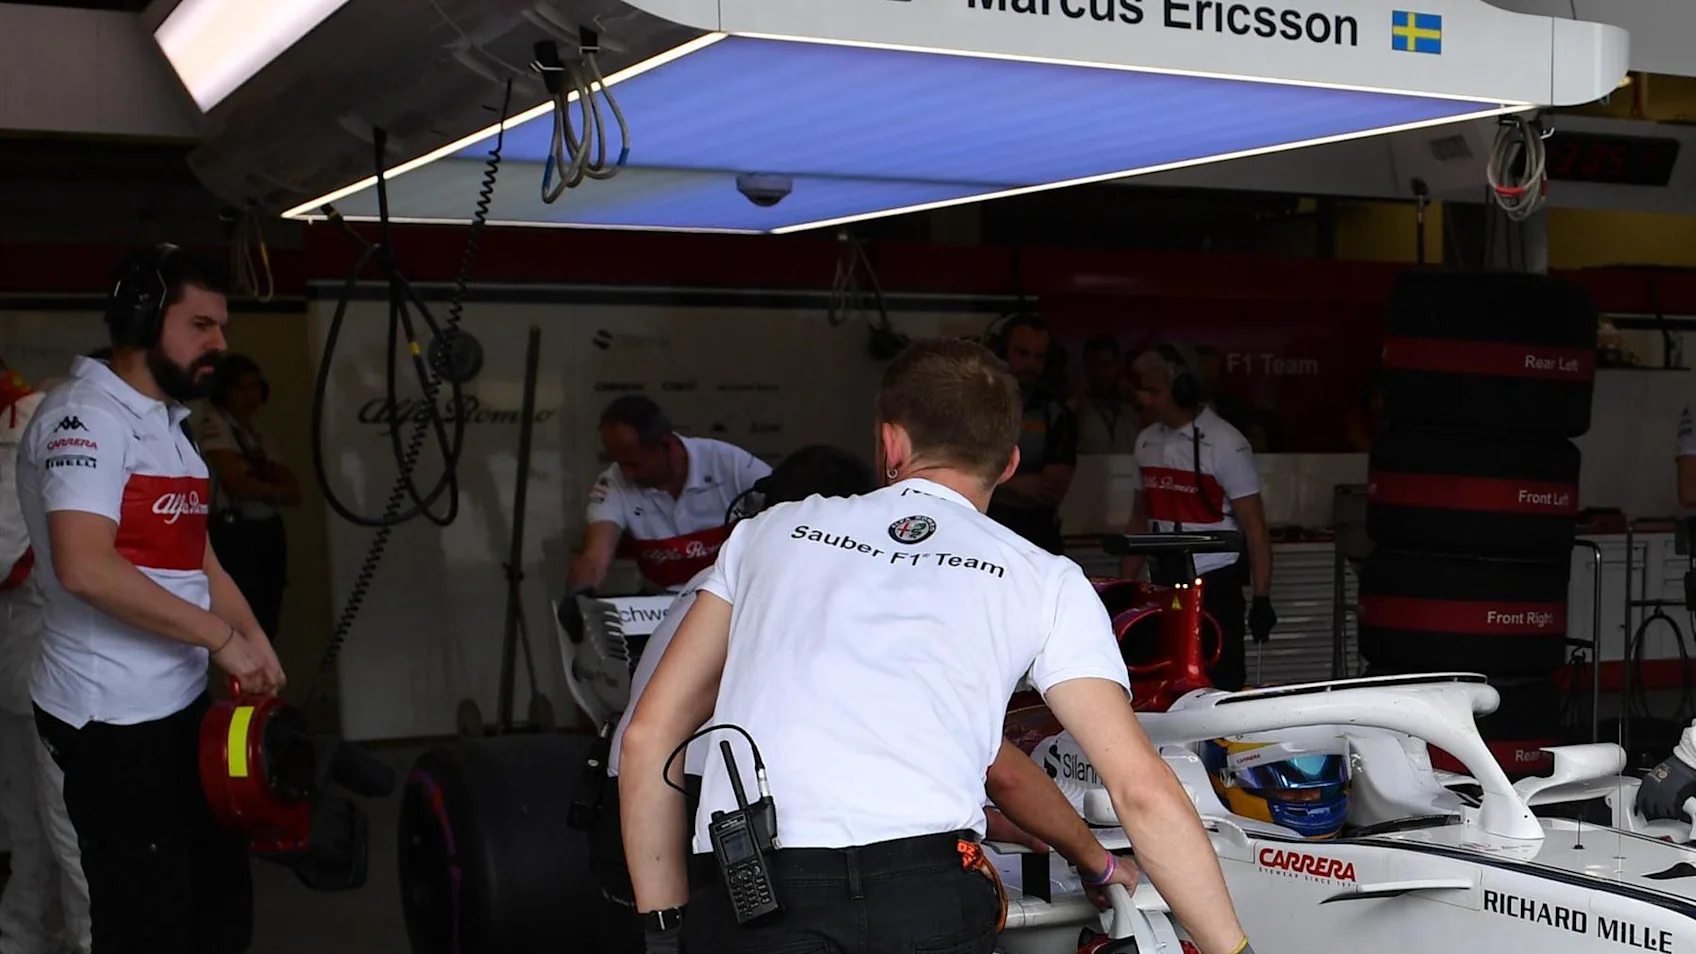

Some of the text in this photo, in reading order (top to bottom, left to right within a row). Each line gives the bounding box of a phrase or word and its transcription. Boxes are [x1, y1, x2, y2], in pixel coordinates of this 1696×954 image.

[1163, 0, 1358, 46] Ericsson
[1226, 352, 1319, 375] F1 Team
[1524, 354, 1579, 372] Rear Left
[444, 394, 556, 423] Romo
[47, 438, 98, 450] CARRERA
[45, 454, 98, 469] PIRELLI
[1518, 489, 1552, 505] Front
[790, 524, 885, 558] Sauber
[935, 552, 1006, 579] Team
[1486, 609, 1524, 625] Front
[1258, 847, 1357, 882] CARRERA
[1483, 889, 1673, 954] RICHARD MILLE
